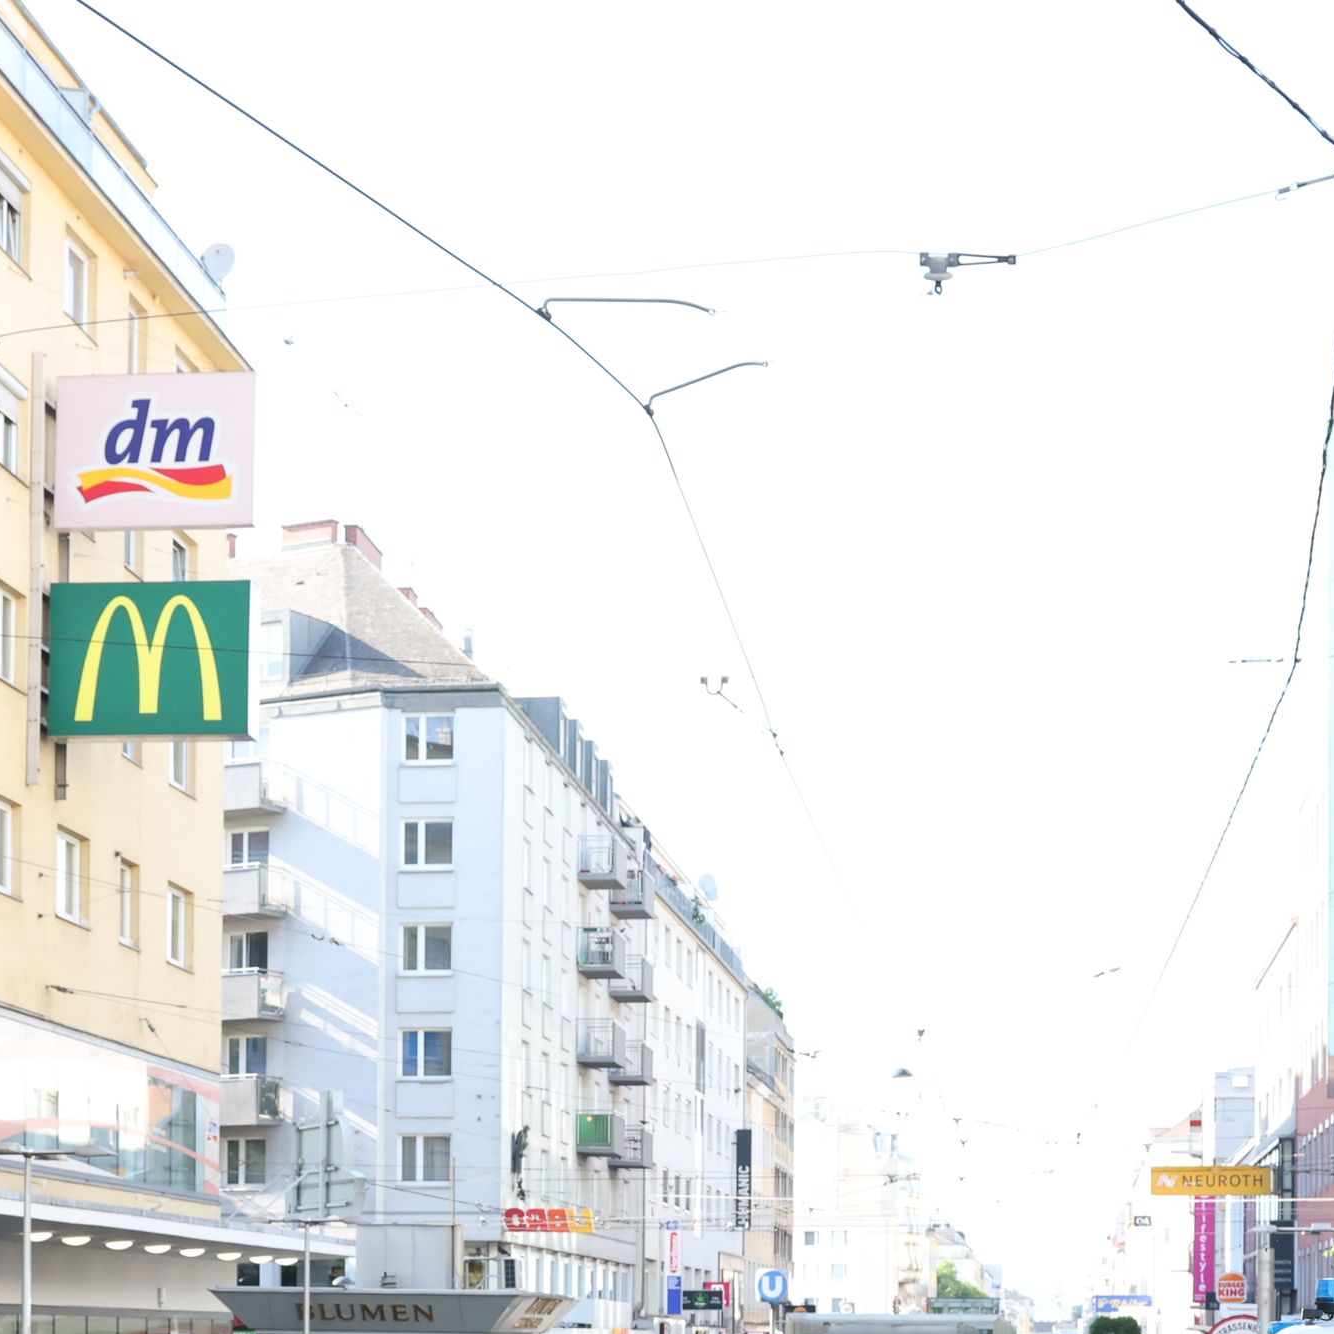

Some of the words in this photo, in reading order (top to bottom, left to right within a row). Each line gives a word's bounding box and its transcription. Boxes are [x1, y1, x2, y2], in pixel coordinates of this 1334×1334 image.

[104, 399, 216, 465] dm
[1182, 1175, 1264, 1188] NEUROTH
[762, 1275, 783, 1299] U
[1218, 1289, 1245, 1297] KING
